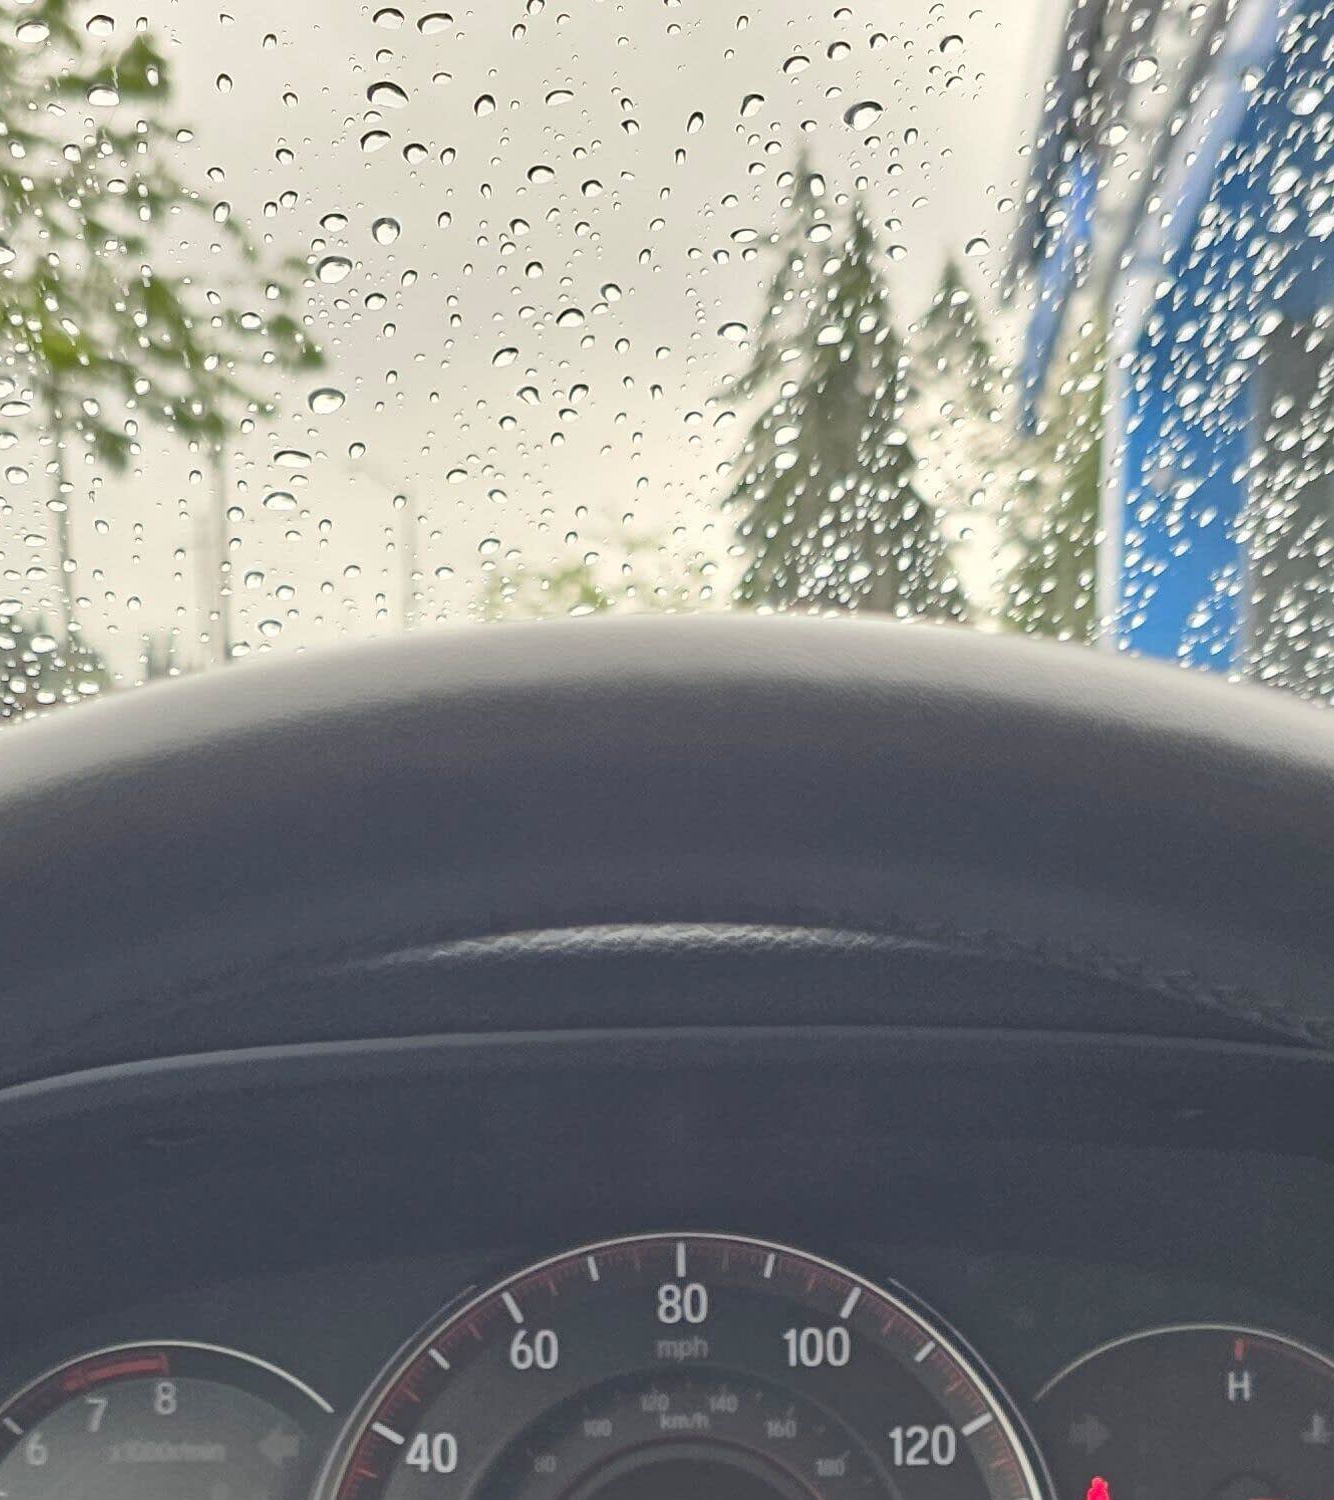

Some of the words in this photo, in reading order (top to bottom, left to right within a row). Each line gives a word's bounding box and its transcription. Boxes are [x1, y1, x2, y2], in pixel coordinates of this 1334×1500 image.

[657, 1283, 708, 1323] 80
[510, 1330, 558, 1369] 60
[657, 1336, 708, 1362] mph
[784, 1328, 850, 1368] 100
[154, 1382, 178, 1415] 8
[1227, 1373, 1250, 1400] H
[85, 1397, 108, 1433] 7
[26, 1431, 48, 1466] 6
[406, 1434, 457, 1473] 40
[889, 1426, 956, 1466] 120
